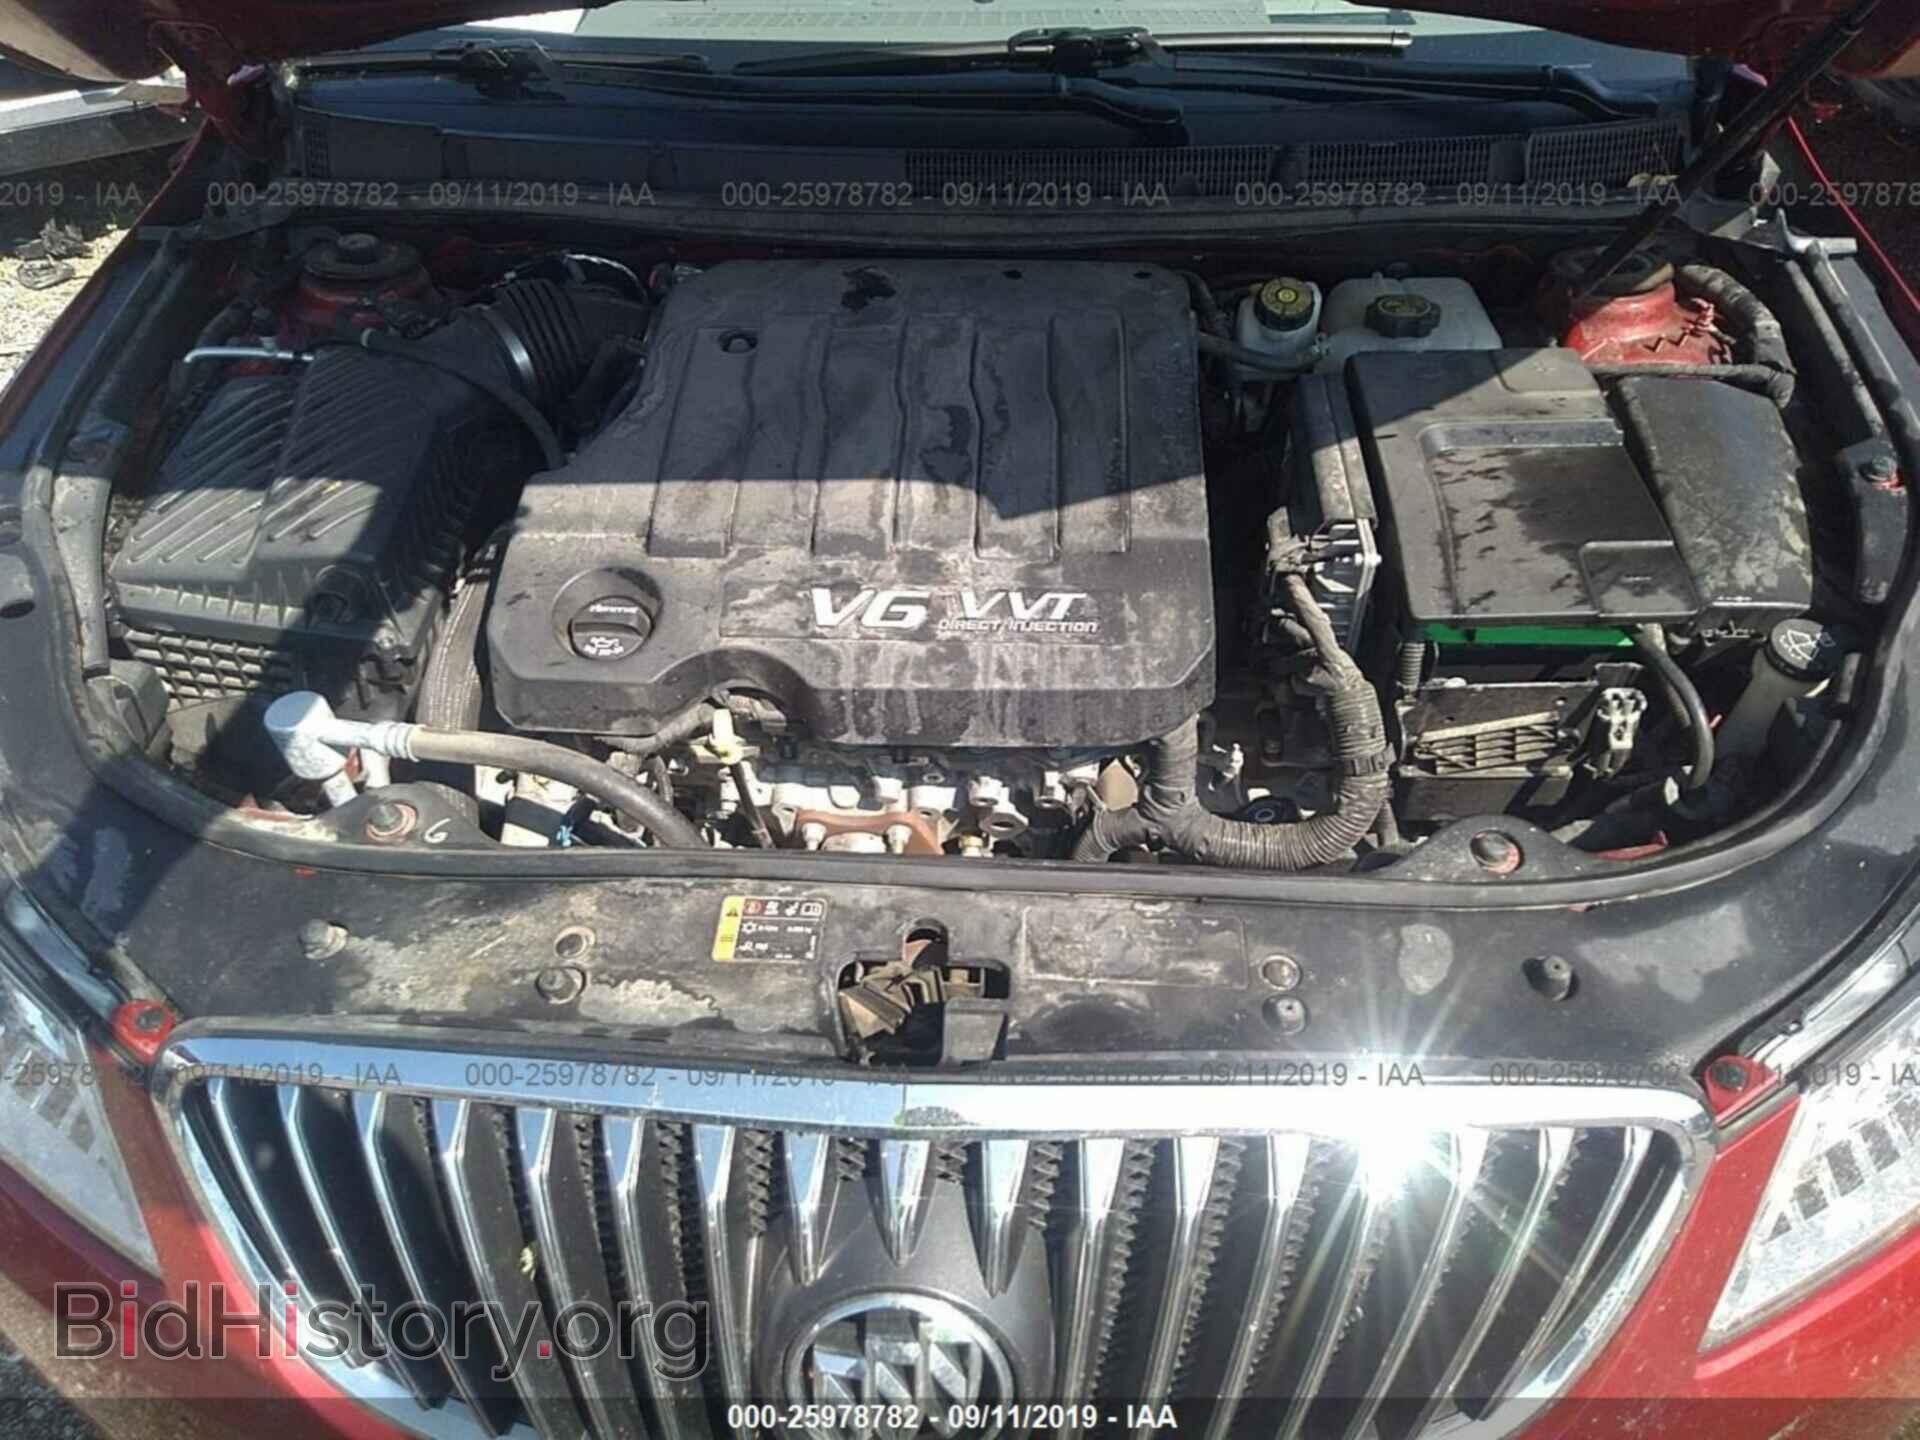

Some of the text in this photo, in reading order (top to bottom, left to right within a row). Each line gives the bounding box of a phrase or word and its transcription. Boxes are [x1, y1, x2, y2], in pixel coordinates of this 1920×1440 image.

[811, 587, 1087, 629] V6 VVT
[424, 818, 451, 843] 6
